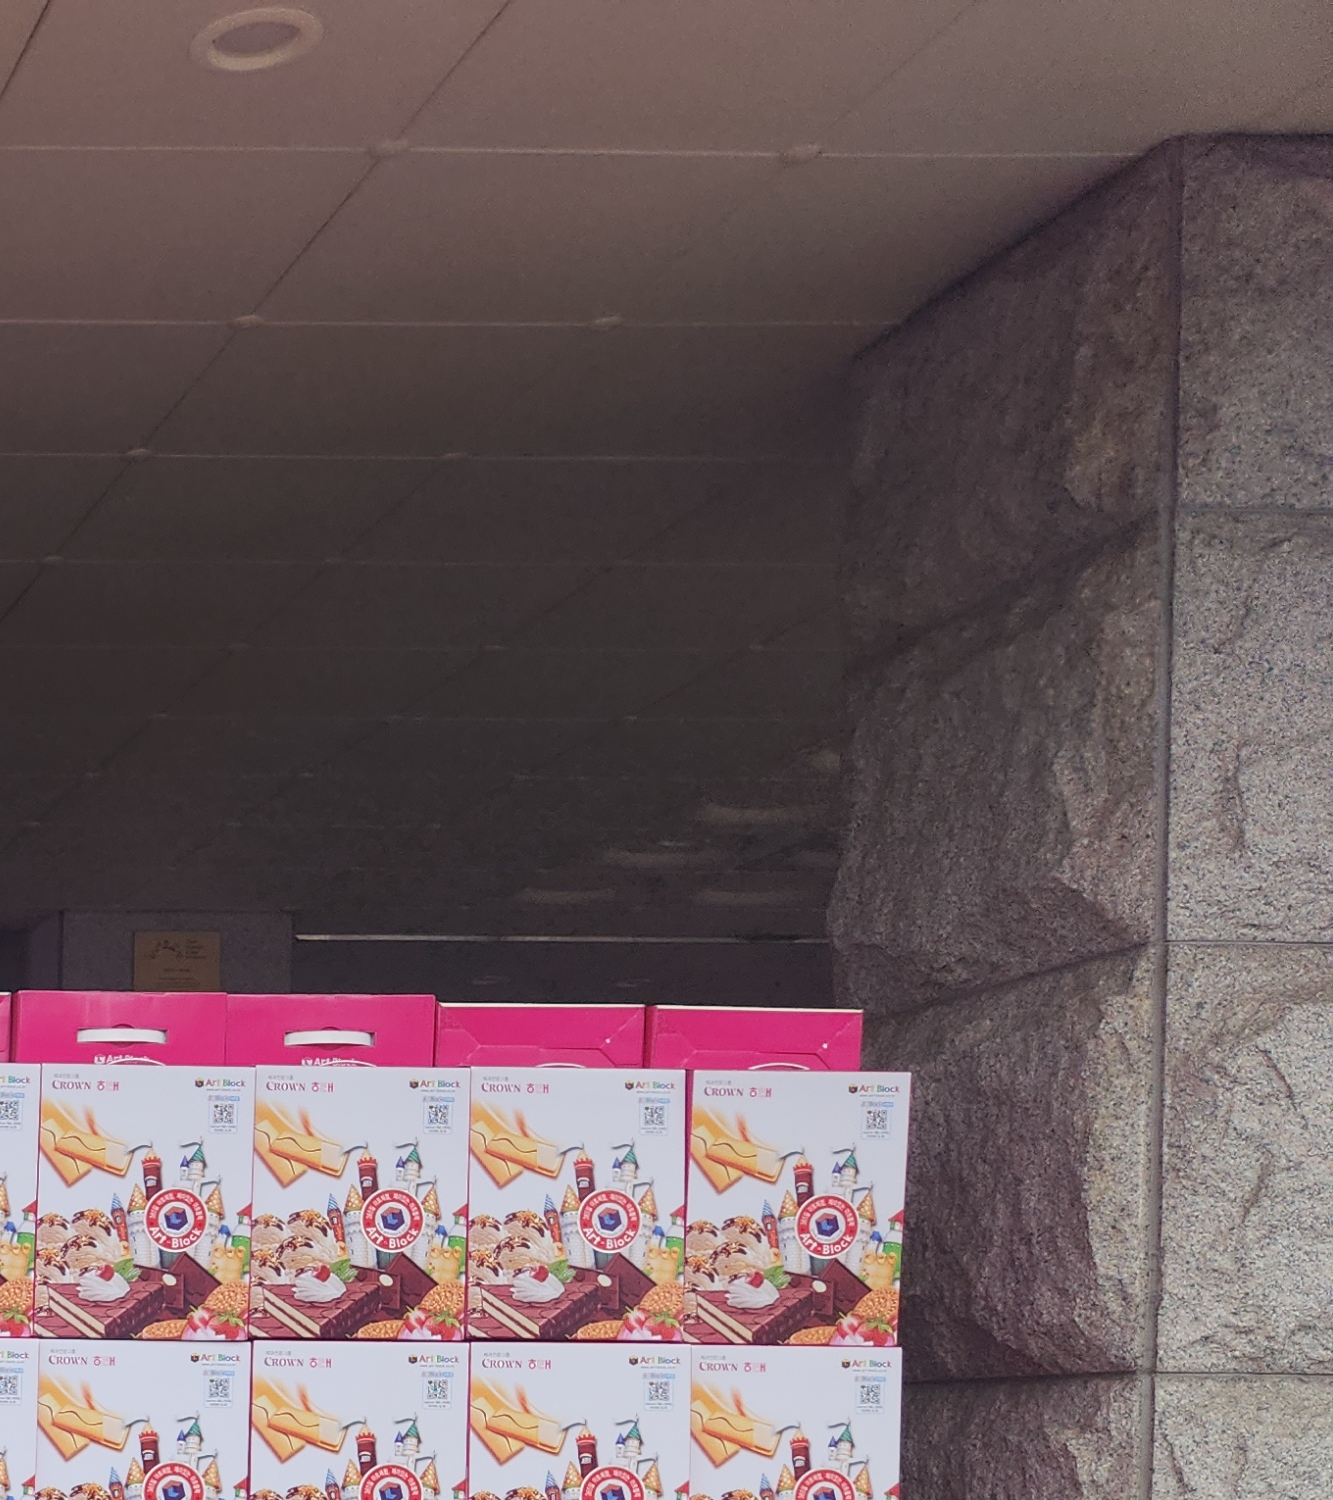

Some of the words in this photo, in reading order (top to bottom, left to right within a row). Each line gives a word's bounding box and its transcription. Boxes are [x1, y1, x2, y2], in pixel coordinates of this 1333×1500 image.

[8, 1075, 31, 1083] Block
[420, 1079, 434, 1087] Art
[437, 1079, 460, 1087] Block
[51, 1079, 91, 1089] CROWN
[265, 1081, 305, 1091] CROWN
[481, 1082, 521, 1092] CROWN
[635, 1080, 650, 1088] Art
[652, 1081, 675, 1089] Block
[859, 1084, 874, 1092] Art
[876, 1084, 900, 1092] Block
[703, 1086, 743, 1096] CROWN
[6, 1350, 29, 1358] Block
[200, 1353, 215, 1361] Art
[217, 1353, 241, 1361] Block
[418, 1354, 434, 1362] Art
[436, 1354, 459, 1362] Block
[48, 1355, 87, 1364] CROWN
[264, 1356, 303, 1366] CROWN
[481, 1358, 522, 1368] CROWN
[851, 1359, 866, 1367] Art
[868, 1359, 892, 1367] Block
[698, 1361, 738, 1371] CROWN
